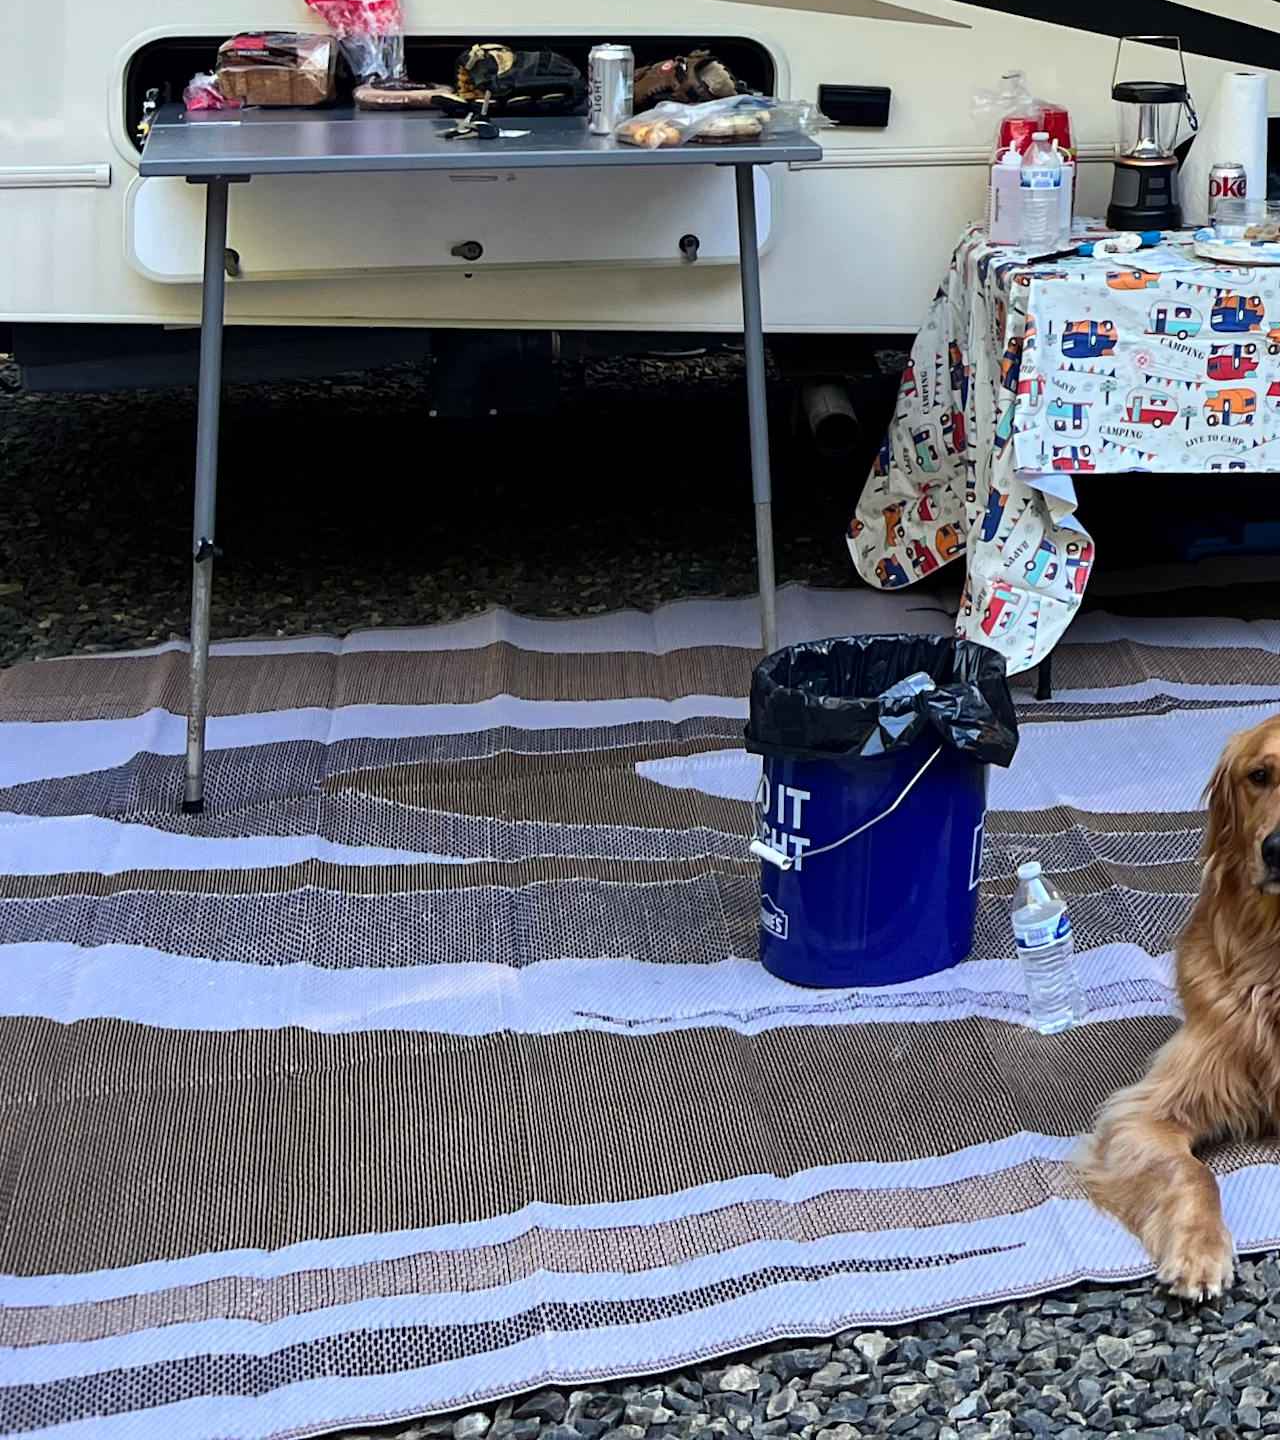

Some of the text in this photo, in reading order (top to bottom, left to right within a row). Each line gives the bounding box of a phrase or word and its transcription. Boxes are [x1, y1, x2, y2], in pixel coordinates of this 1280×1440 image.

[594, 80, 602, 112] LIGHT
[1209, 176, 1247, 197] oke
[1160, 337, 1206, 360] CAMPING
[920, 370, 930, 415] CAMPING
[1098, 425, 1144, 440] CAMPING
[1185, 436, 1206, 448] LIVE
[1220, 435, 1245, 446] CAMP
[1003, 540, 1030, 568] HAPPY
[777, 784, 811, 829] IT
